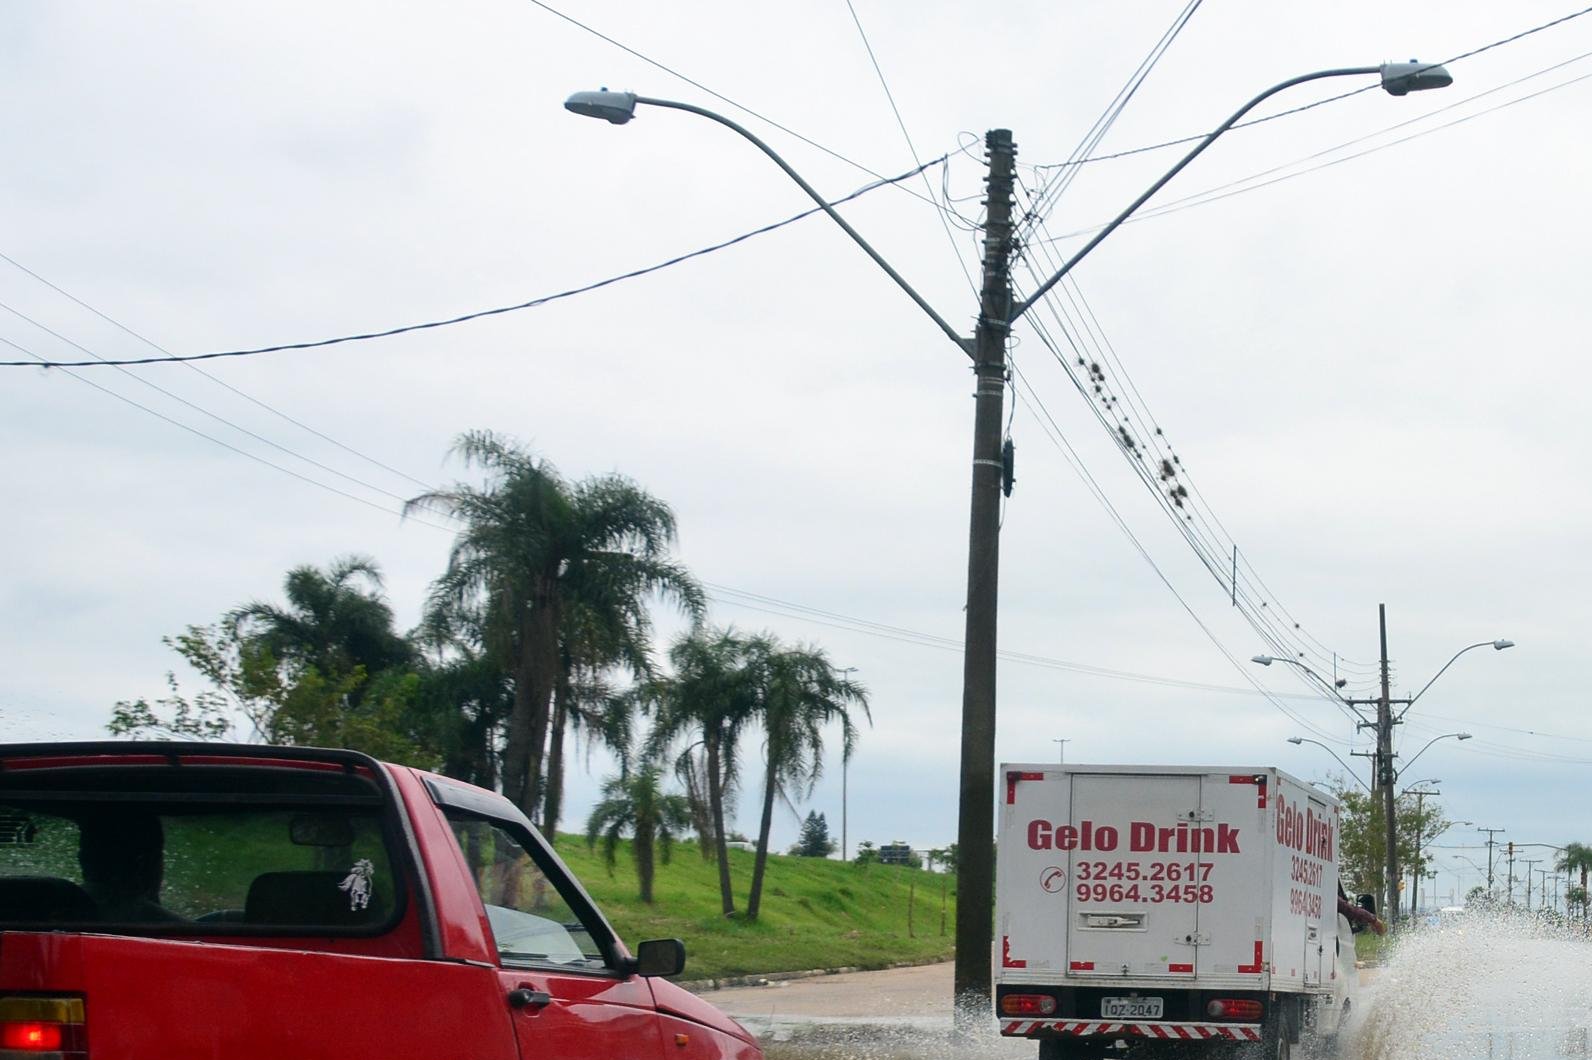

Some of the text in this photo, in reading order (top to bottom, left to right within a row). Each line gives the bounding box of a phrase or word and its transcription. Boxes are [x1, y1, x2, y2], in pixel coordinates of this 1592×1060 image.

[1027, 819, 1241, 854] Gelo Drink
[1276, 793, 1333, 862] Gelo Drink
[1076, 861, 1214, 882] 3245.2617
[1290, 854, 1322, 889] 3245.2617
[1076, 883, 1214, 904] 9964.3458
[1290, 887, 1322, 920] 9964.3458
